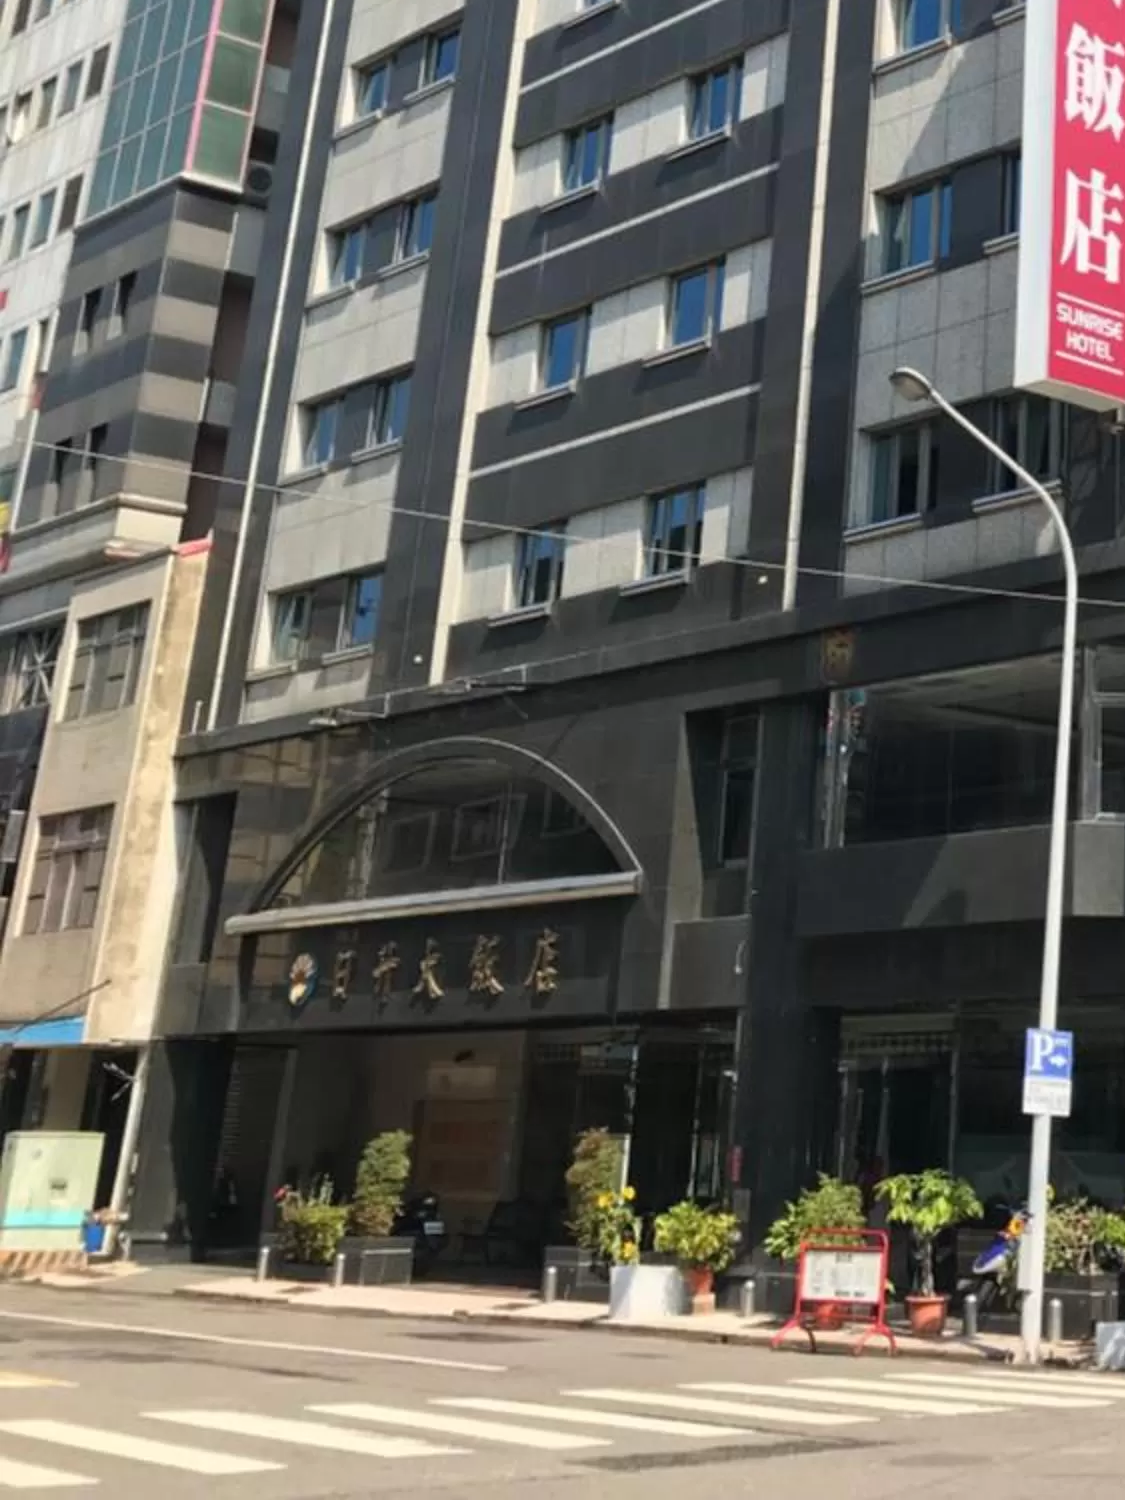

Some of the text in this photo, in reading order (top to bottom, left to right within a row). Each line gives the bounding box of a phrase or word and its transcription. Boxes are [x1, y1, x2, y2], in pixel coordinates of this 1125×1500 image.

[1055, 302, 1124, 341] SUNRISE
[1065, 328, 1115, 362] HOTEL
[1030, 1032, 1054, 1072] P
